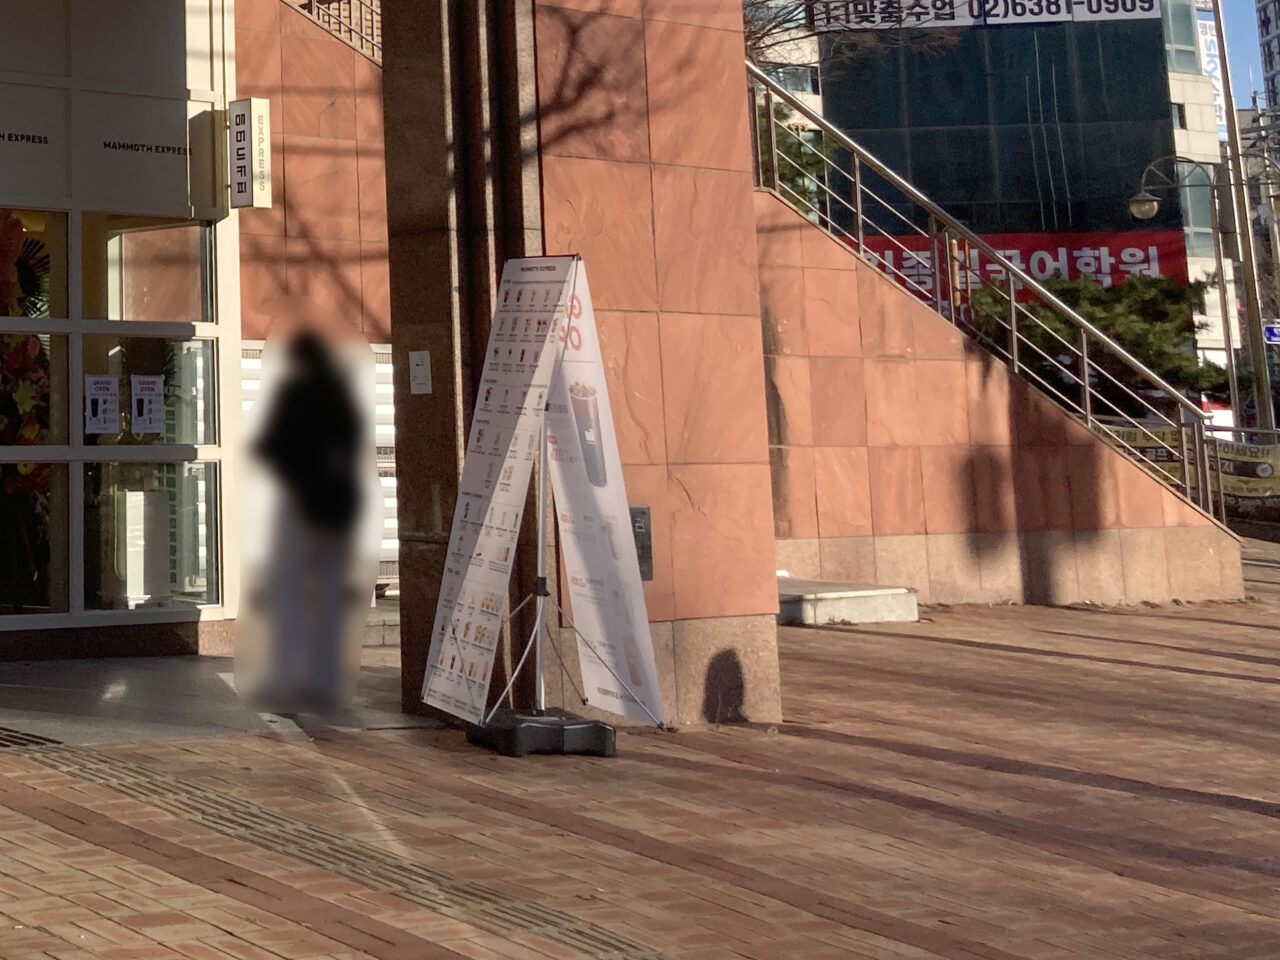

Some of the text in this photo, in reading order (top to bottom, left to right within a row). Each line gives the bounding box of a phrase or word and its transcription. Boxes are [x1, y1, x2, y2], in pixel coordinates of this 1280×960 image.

[7, 132, 48, 145] EXPRESS
[103, 141, 192, 156] MAMMOTH EXPRESS
[257, 115, 265, 191] EXPRESS
